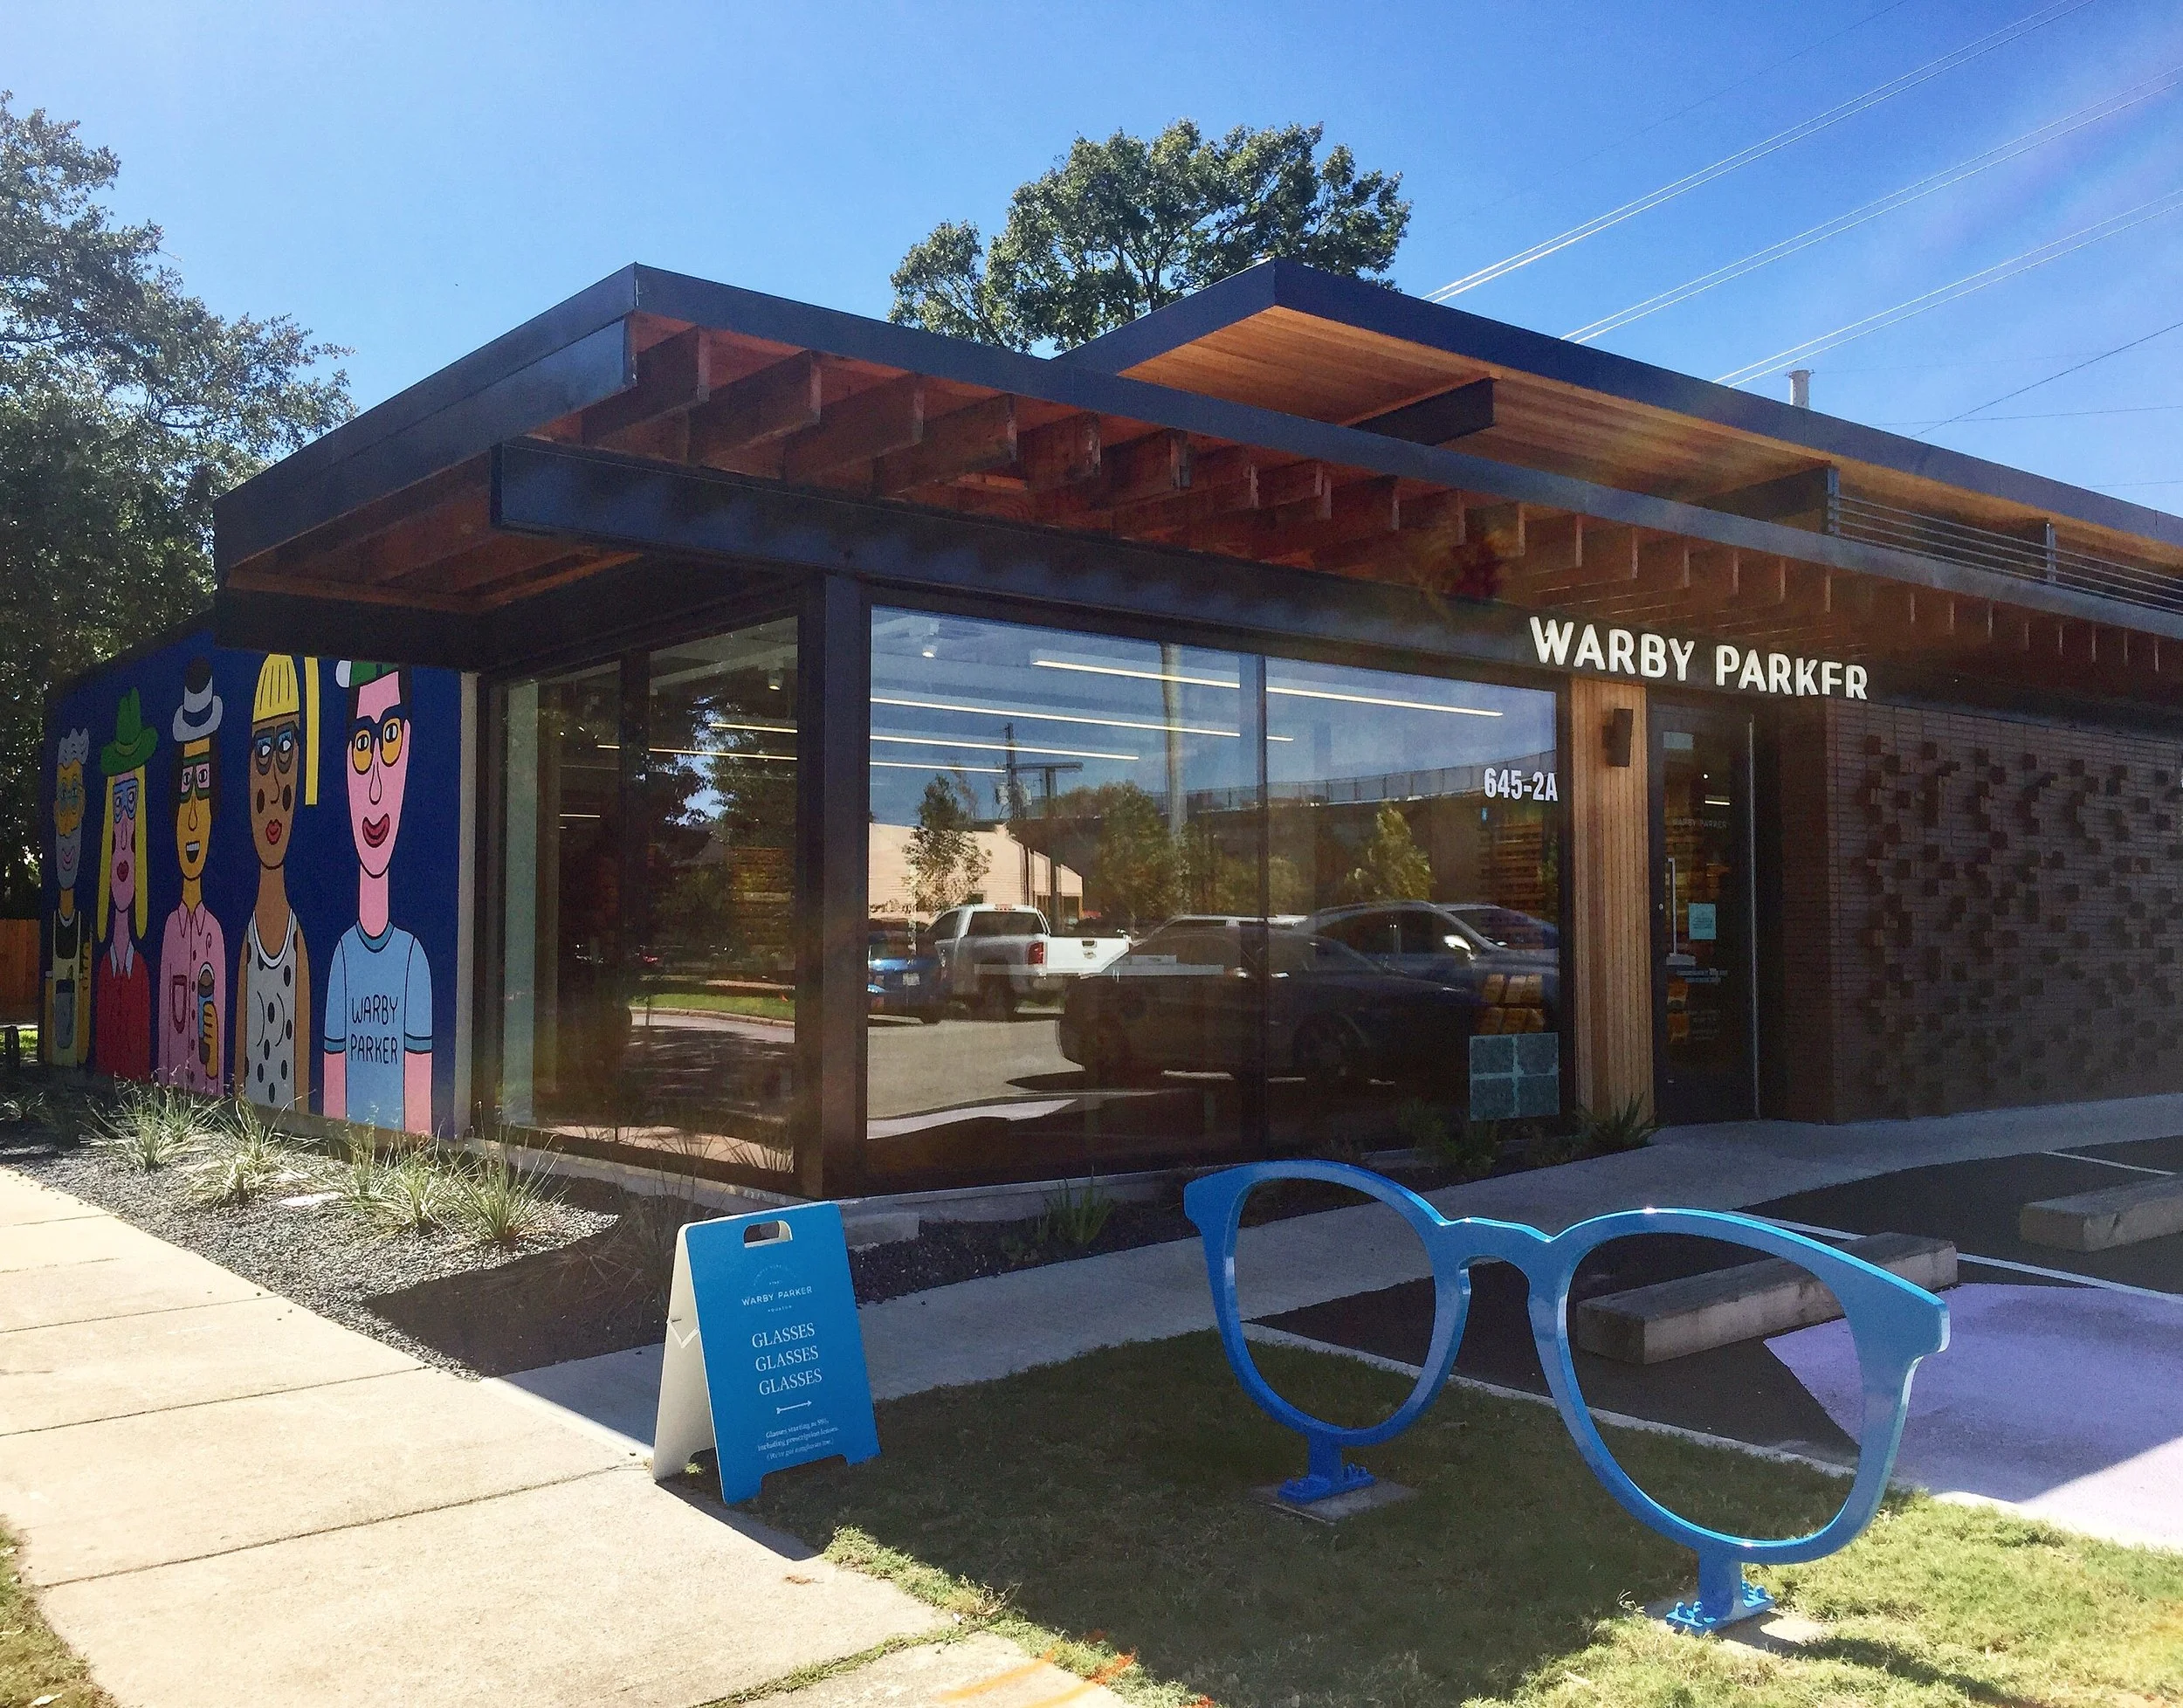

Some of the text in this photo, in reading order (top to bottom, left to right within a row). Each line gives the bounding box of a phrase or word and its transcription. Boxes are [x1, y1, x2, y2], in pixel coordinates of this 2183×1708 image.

[1530, 616, 1868, 699] WARBY PARKER
[1484, 768, 1558, 802] 645-2A
[352, 994, 398, 1025] WARBY
[350, 1033, 397, 1064] PARKER
[741, 1285, 813, 1306] WARBY PARKER
[752, 1322, 815, 1348] GLASSES
[755, 1345, 819, 1372] GLASSES
[759, 1367, 823, 1395] GLASSES
